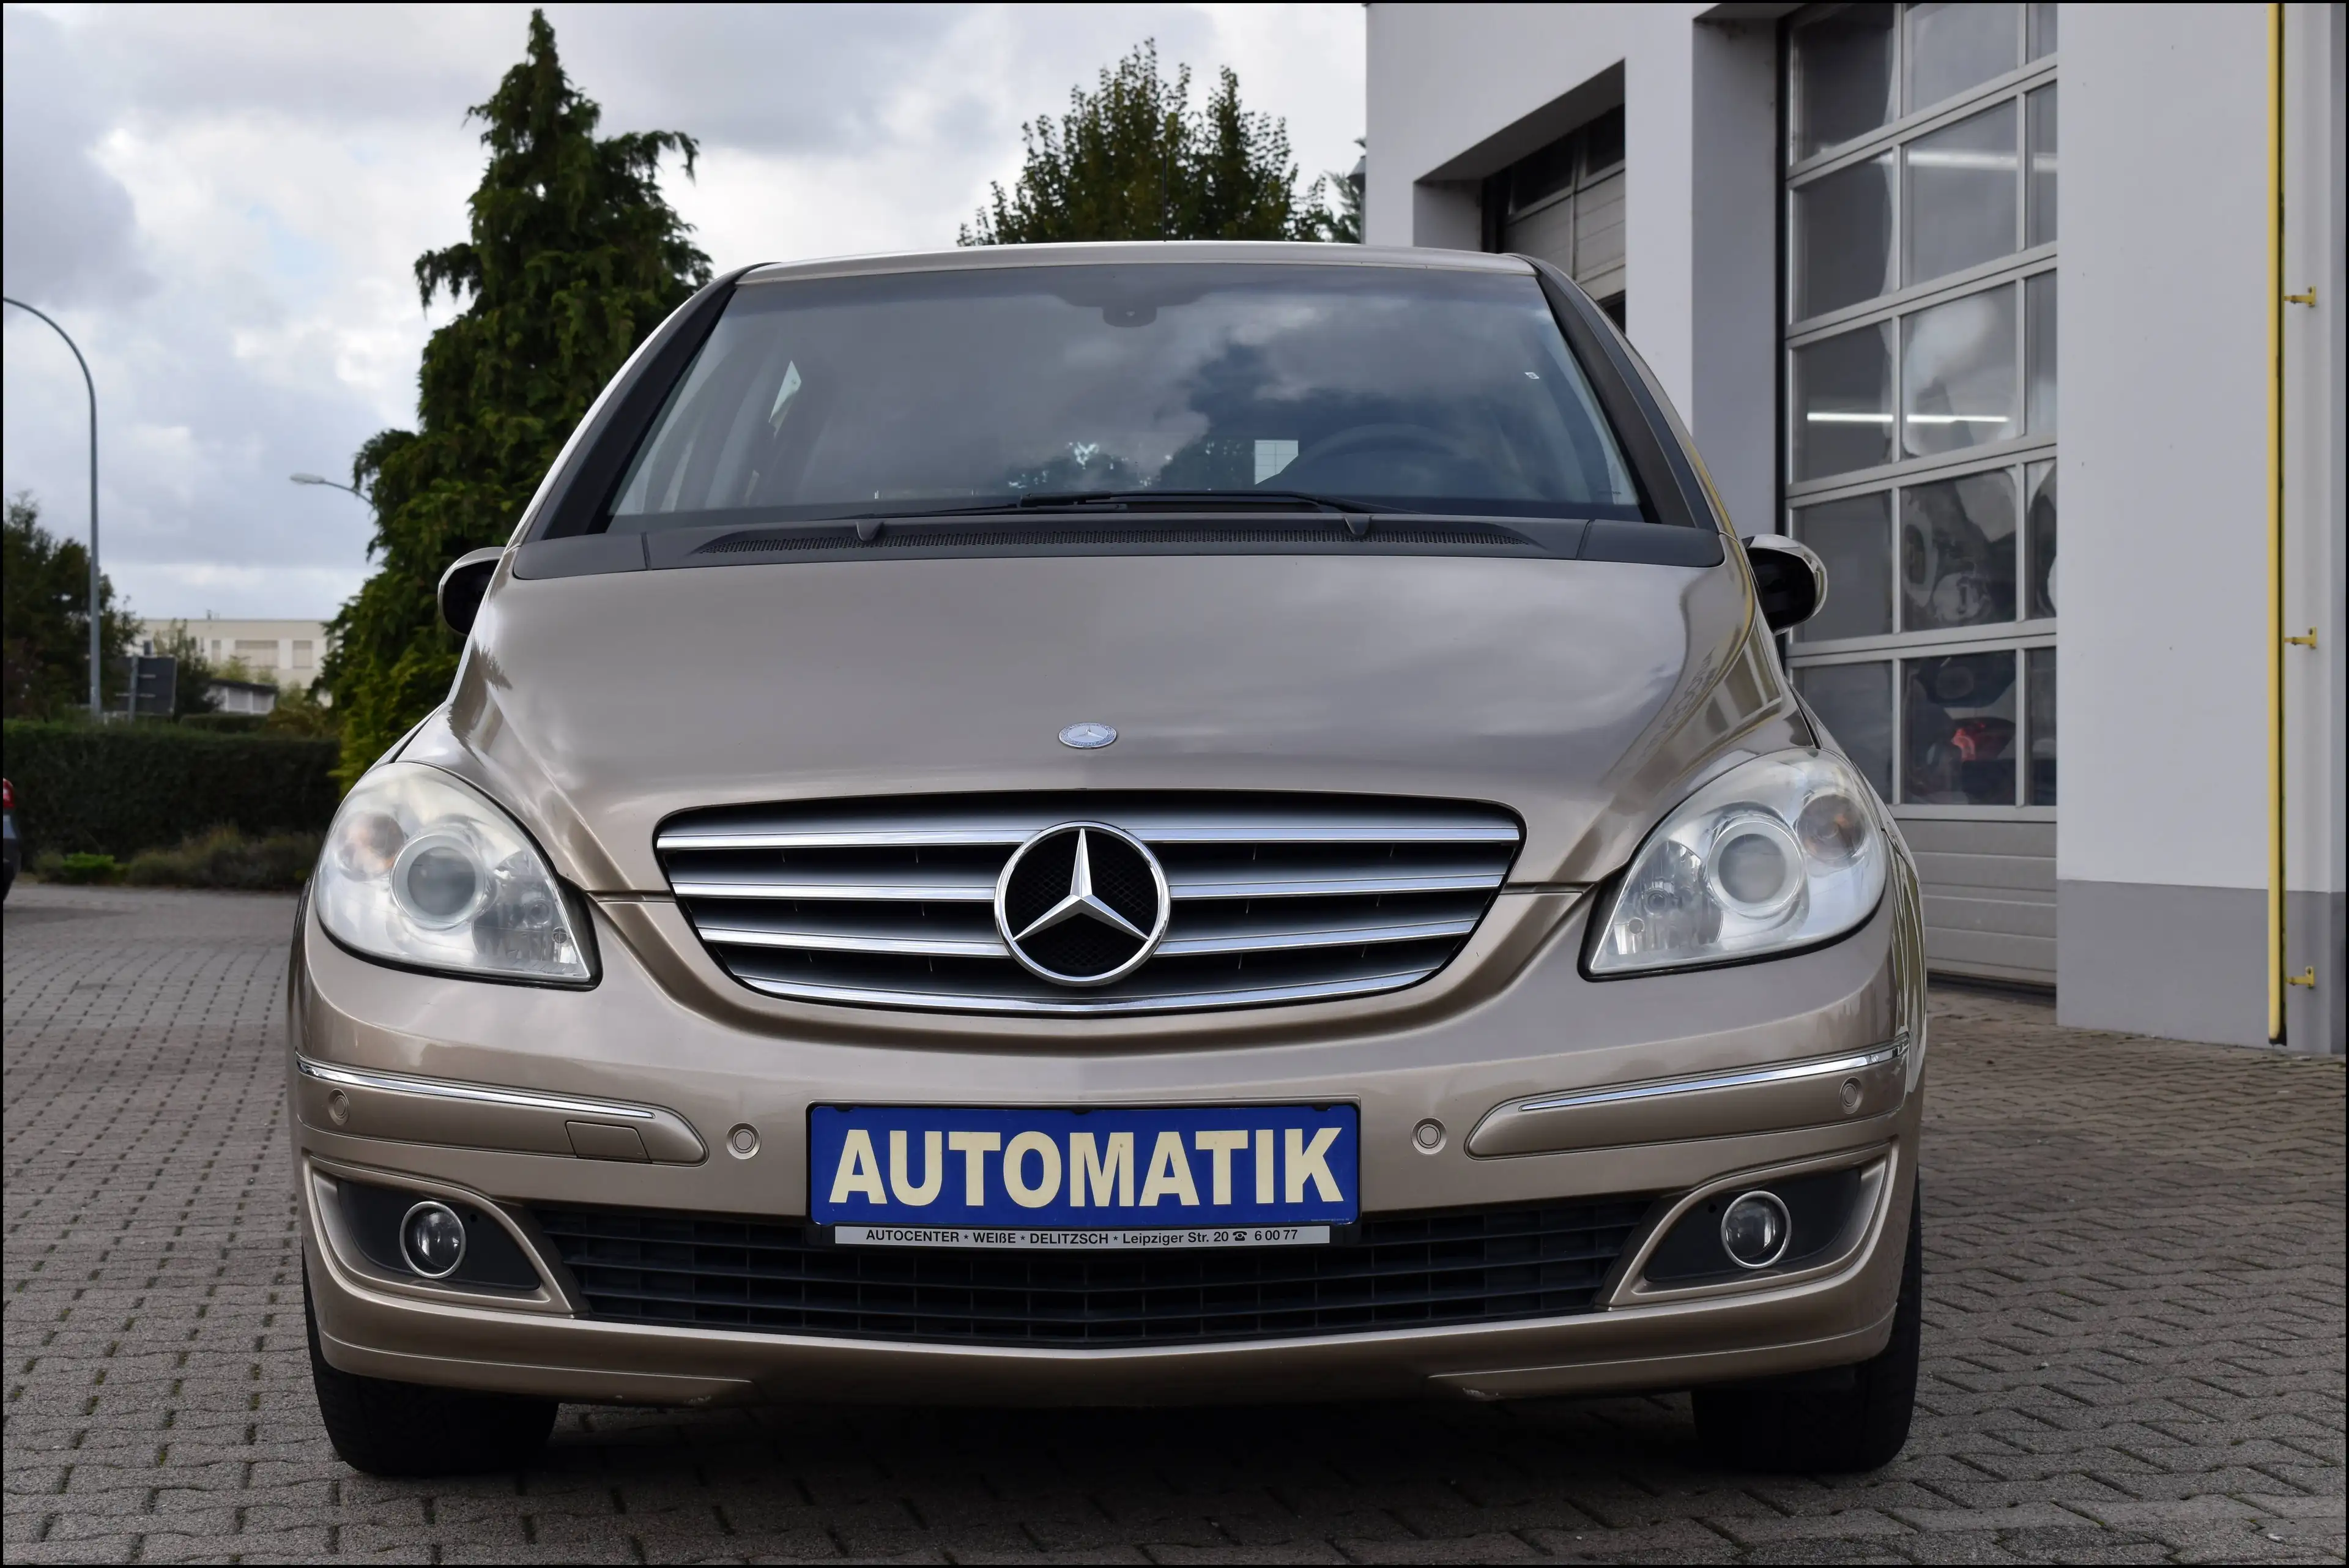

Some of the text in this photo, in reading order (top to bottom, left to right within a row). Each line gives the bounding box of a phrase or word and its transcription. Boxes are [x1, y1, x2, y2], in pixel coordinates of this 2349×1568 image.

[829, 1128, 1343, 1208] AUTOMATIK
[866, 1229, 960, 1243] AUTOCENTER
[973, 1232, 1016, 1244] WEIßE
[1030, 1232, 1108, 1244] DELITZSCH
[1123, 1232, 1184, 1246] Leipziger
[1187, 1232, 1209, 1243] Str.
[1213, 1231, 1229, 1243] 20
